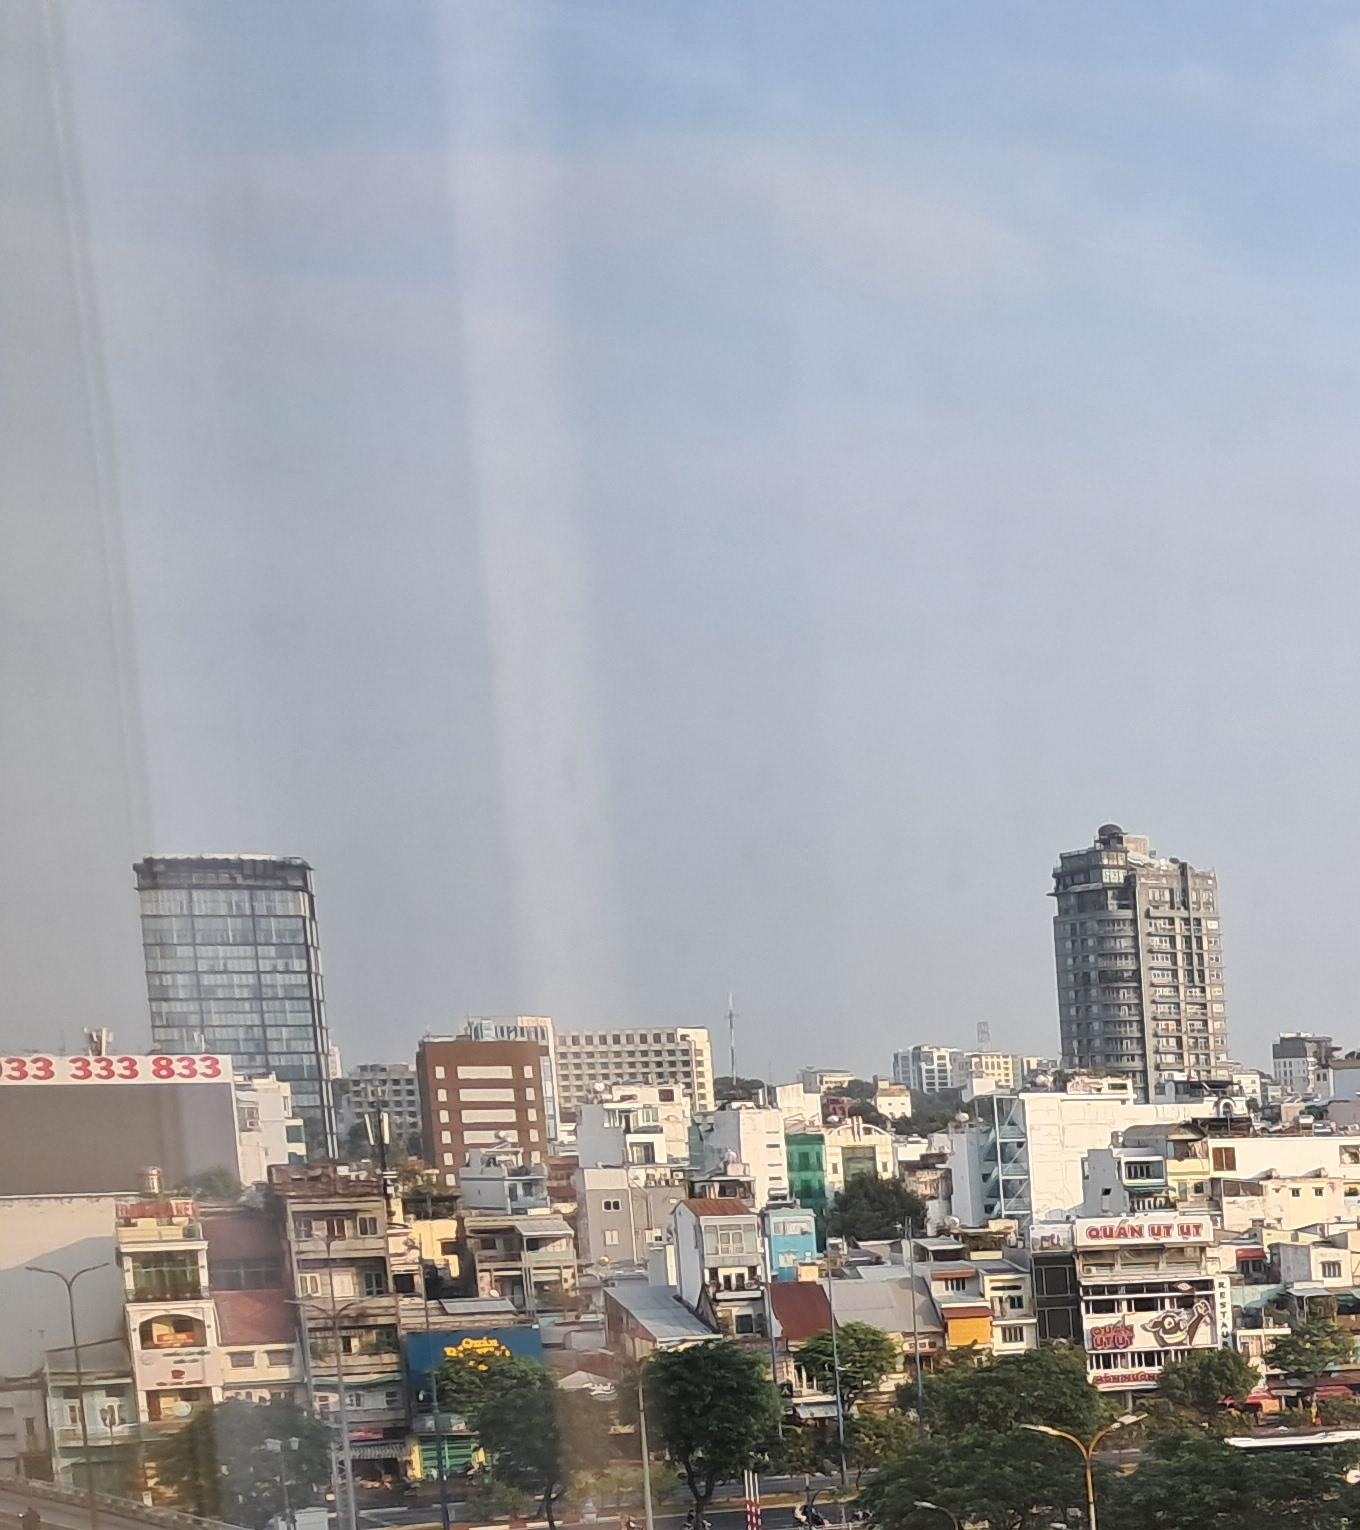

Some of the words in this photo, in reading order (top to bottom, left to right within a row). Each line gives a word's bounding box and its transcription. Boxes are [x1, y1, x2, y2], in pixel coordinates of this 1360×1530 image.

[0, 1057, 55, 1080] 33
[69, 1056, 139, 1080] 333
[152, 1056, 222, 1079] 833
